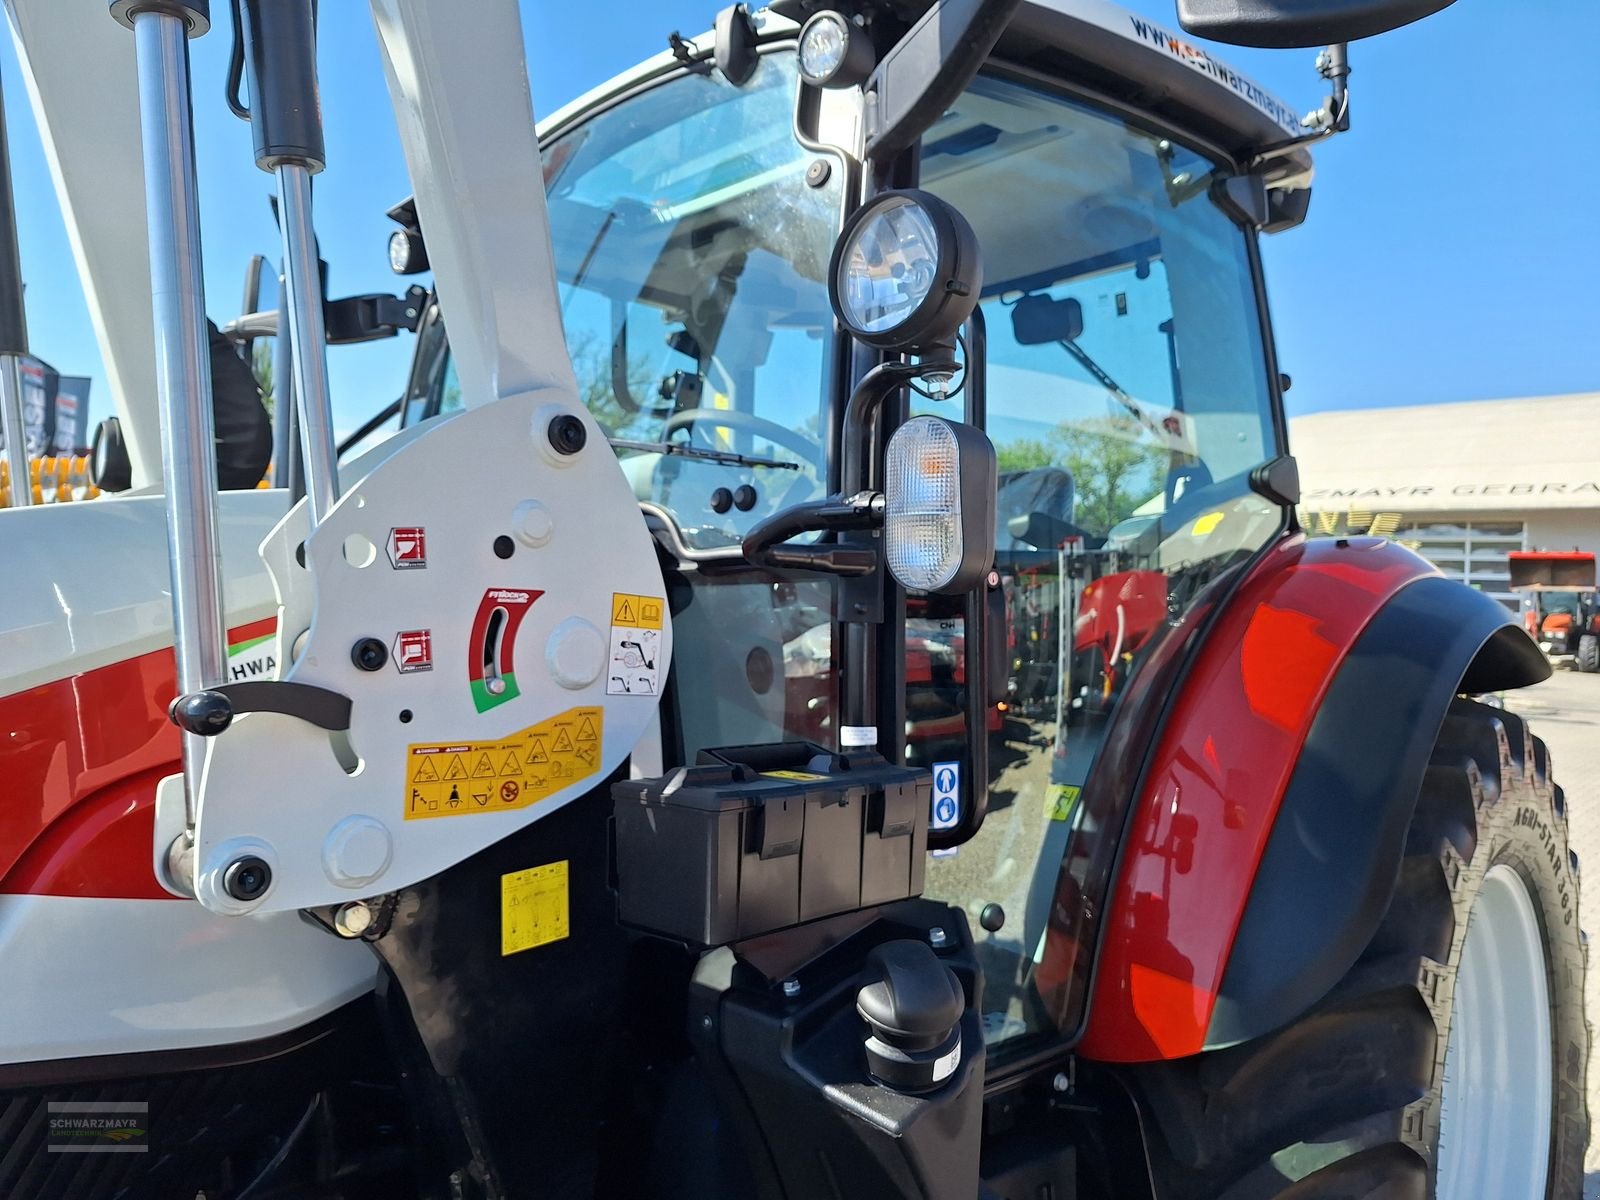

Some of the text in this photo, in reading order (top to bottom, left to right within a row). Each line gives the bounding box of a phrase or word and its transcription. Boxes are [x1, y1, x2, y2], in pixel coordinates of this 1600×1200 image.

[1302, 486, 1434, 498] ZMAYR
[230, 655, 276, 681] HWA
[1513, 807, 1562, 877] AGRI-STAR
